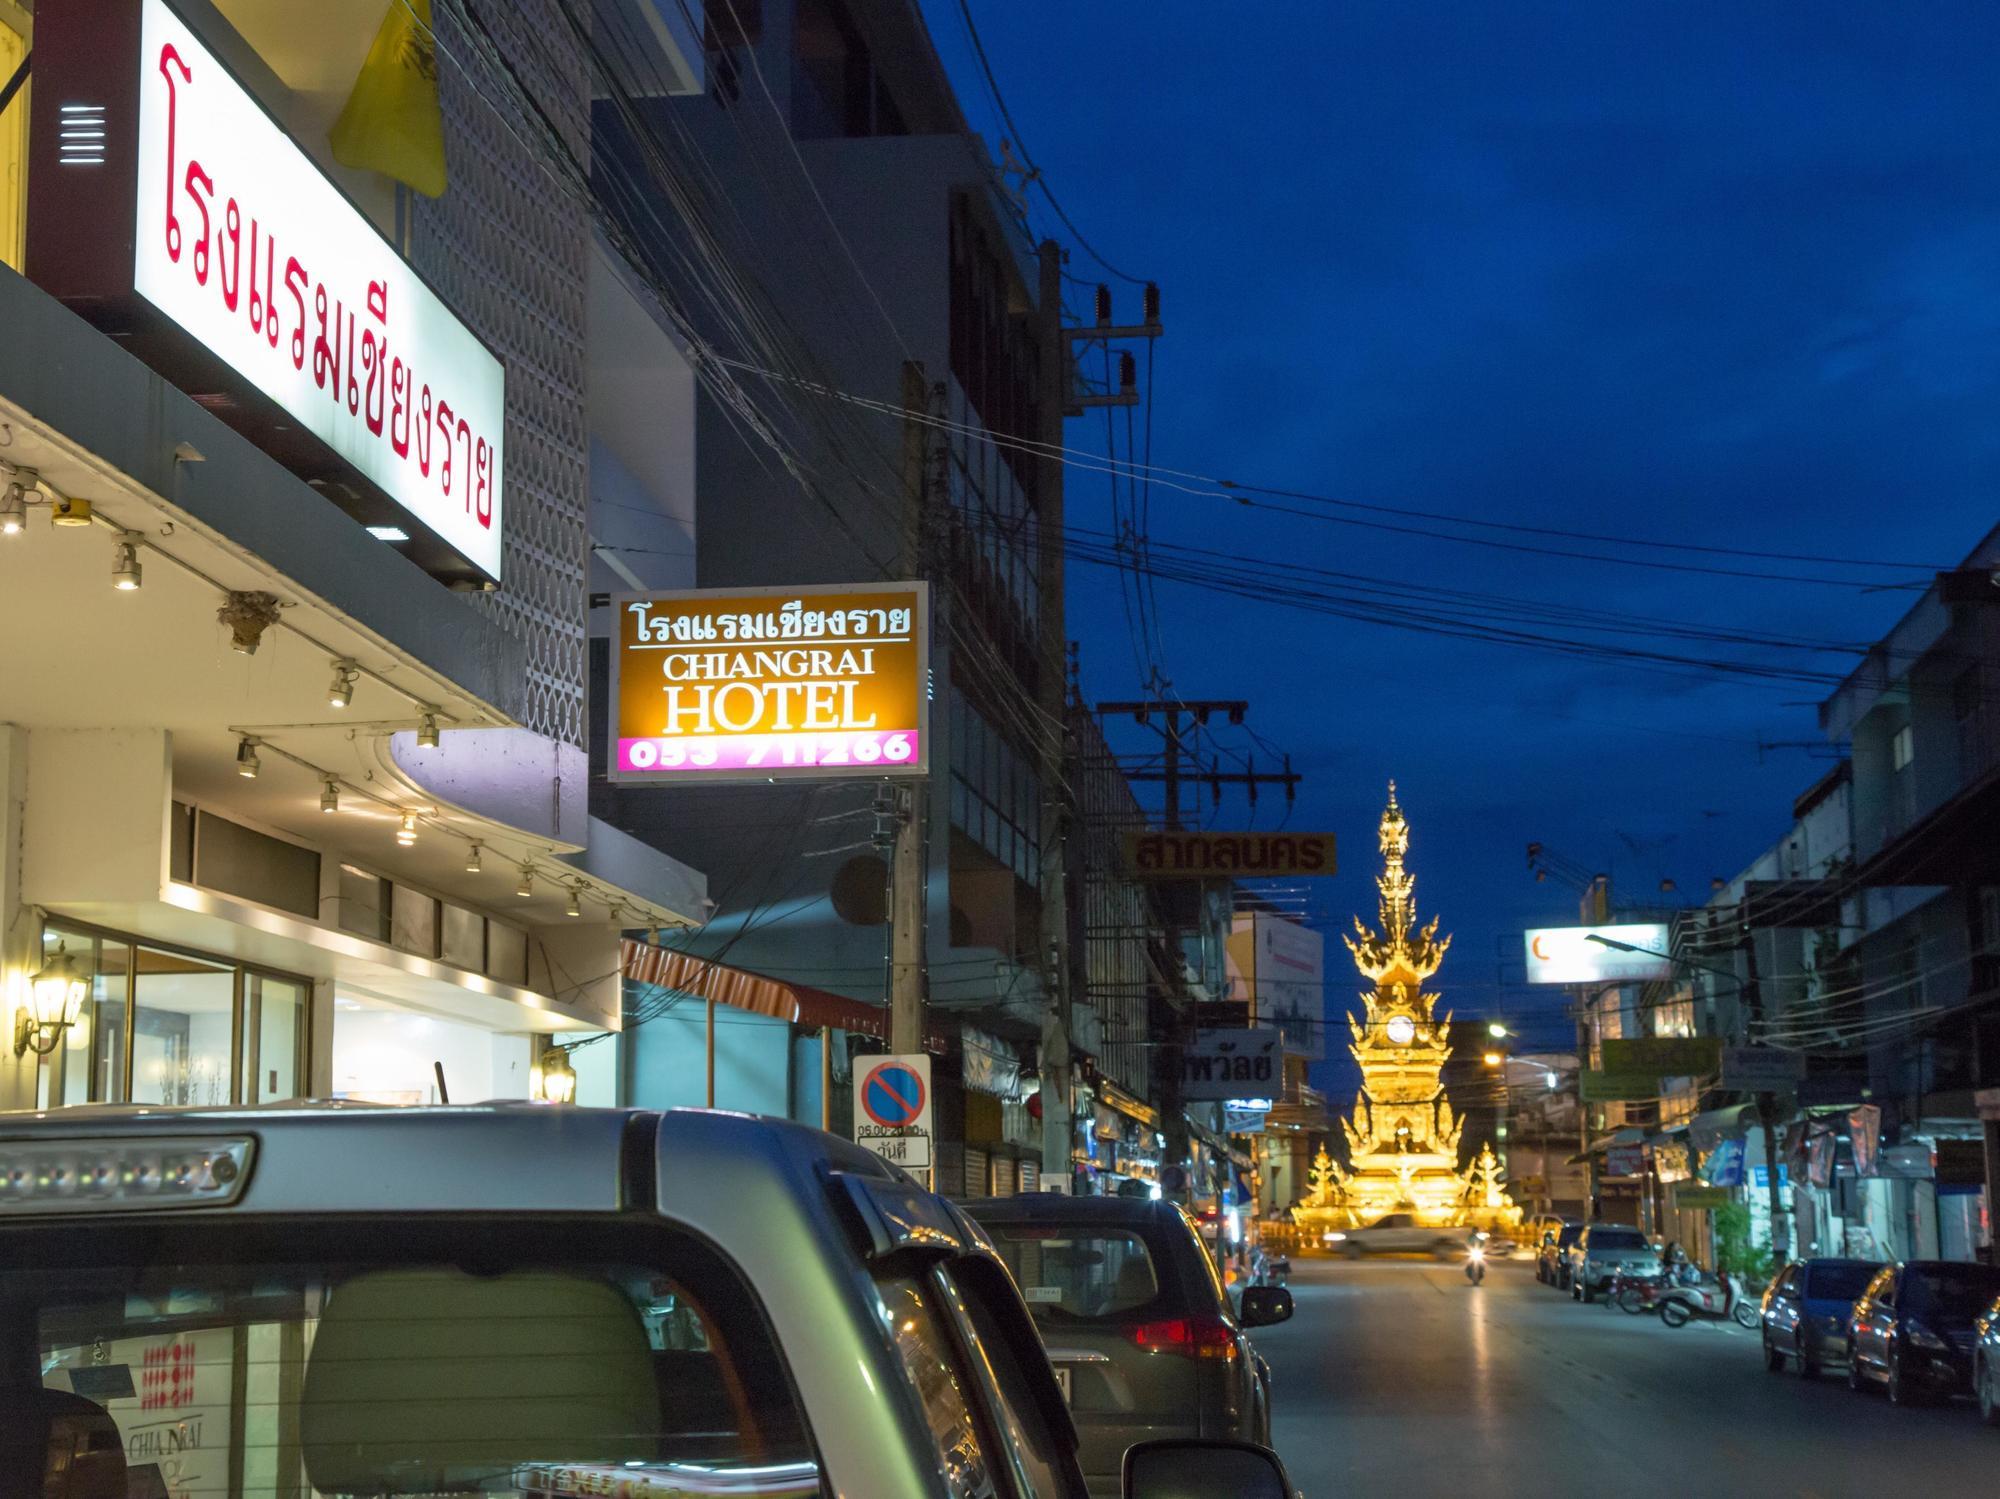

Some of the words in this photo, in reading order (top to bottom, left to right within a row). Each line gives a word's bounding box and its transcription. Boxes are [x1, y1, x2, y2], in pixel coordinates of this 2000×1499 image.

[159, 42, 493, 530] โรงแรมเชียงราย
[628, 600, 911, 642] โรงแรมเชียงราย
[662, 648, 876, 681] CHIANGRAI
[662, 680, 876, 734] HOTEL
[628, 741, 719, 768] 053
[745, 733, 911, 766] 711266
